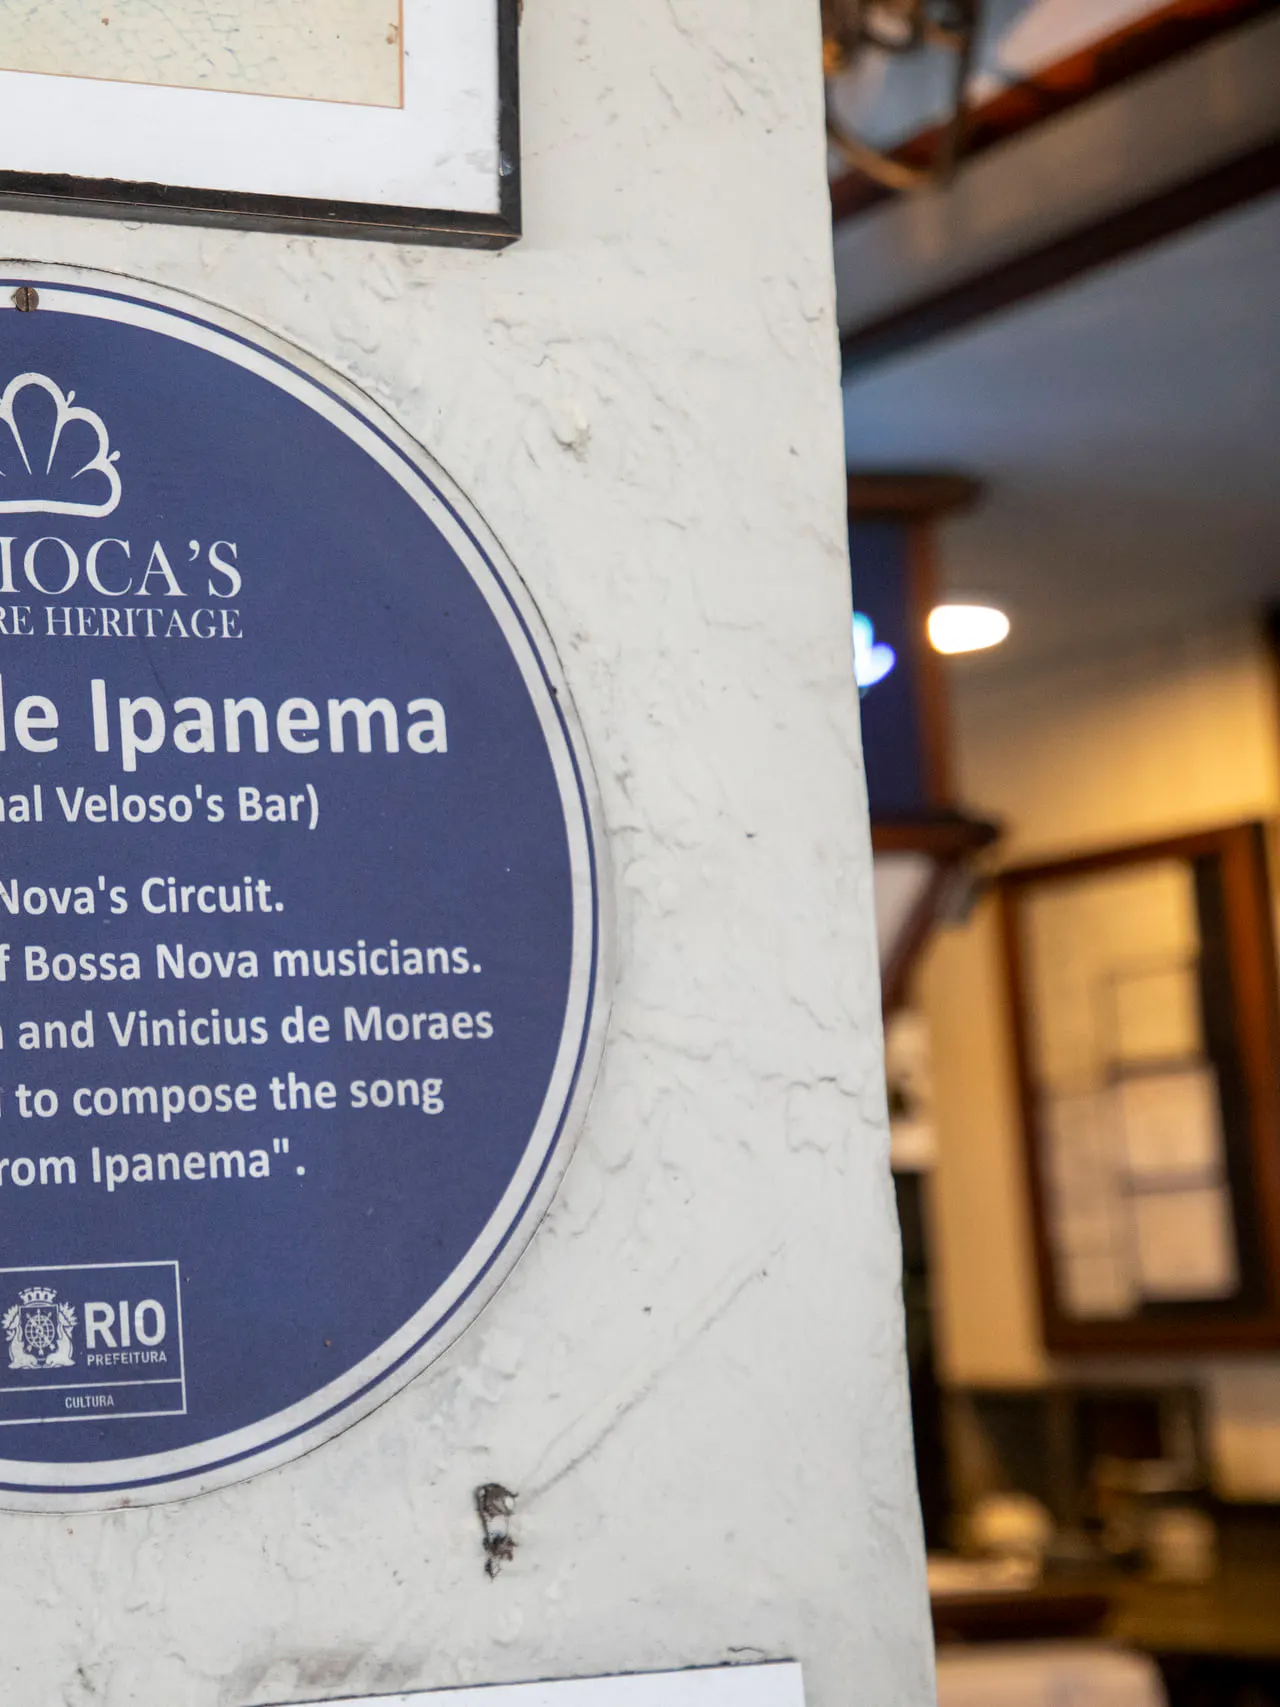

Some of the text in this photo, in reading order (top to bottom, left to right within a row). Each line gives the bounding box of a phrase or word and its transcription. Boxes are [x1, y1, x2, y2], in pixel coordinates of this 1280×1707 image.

[45, 606, 243, 639] HERITAGE
[90, 678, 448, 773] Ipanema
[55, 783, 225, 823] Veloso's
[238, 783, 319, 830] Bar)
[141, 875, 284, 914] Circuit.
[24, 945, 141, 982] Bossa
[156, 943, 259, 980] Nova
[273, 939, 482, 977] musicians.
[18, 1009, 95, 1050] and
[107, 1008, 269, 1047] Vinicius
[281, 1005, 330, 1044] de
[344, 1006, 494, 1042] Moraes
[14, 1083, 59, 1118] to
[73, 1083, 257, 1123] compose
[268, 1071, 337, 1111] the
[349, 1078, 444, 1115] song
[84, 1299, 166, 1349] RIO
[87, 1351, 167, 1366] PREFEITURA
[65, 1395, 114, 1408] CULTURA
